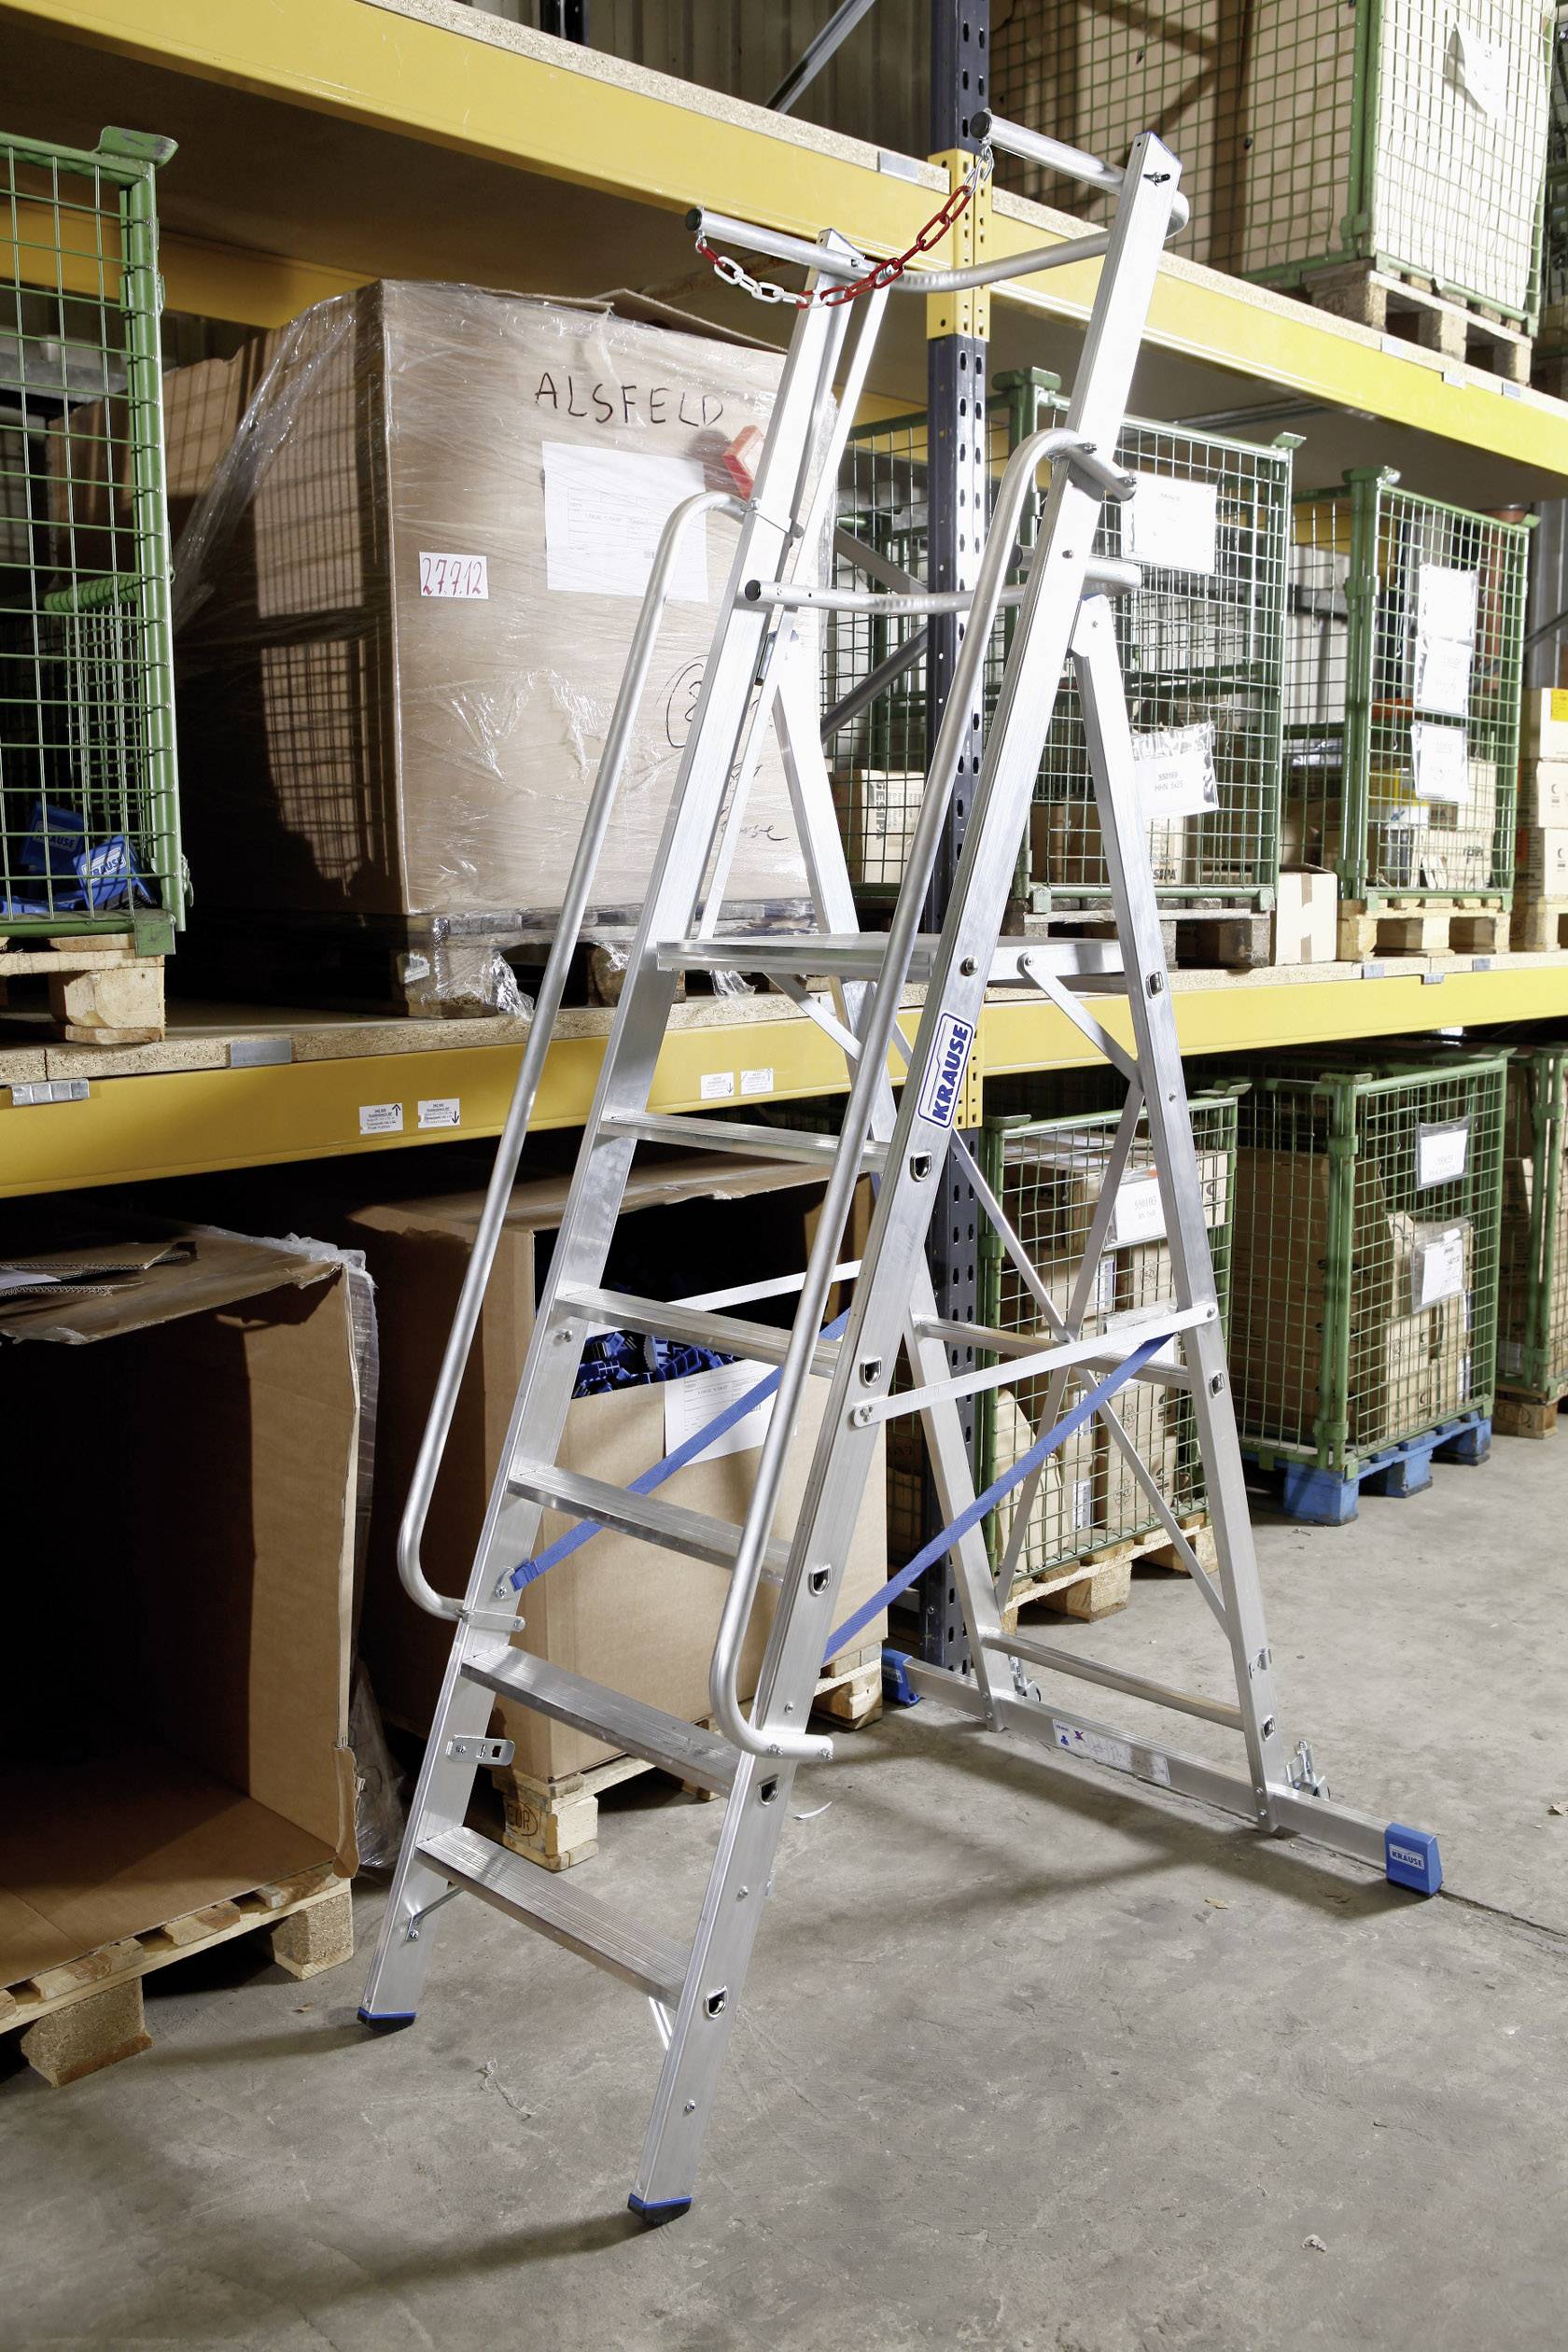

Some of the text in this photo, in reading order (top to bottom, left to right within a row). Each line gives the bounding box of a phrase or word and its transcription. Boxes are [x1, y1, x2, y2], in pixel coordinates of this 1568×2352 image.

[535, 371, 724, 427] ALSFELD
[931, 1024, 968, 1122] KRAUSE
[1392, 1850, 1422, 1867] KRAUSE
